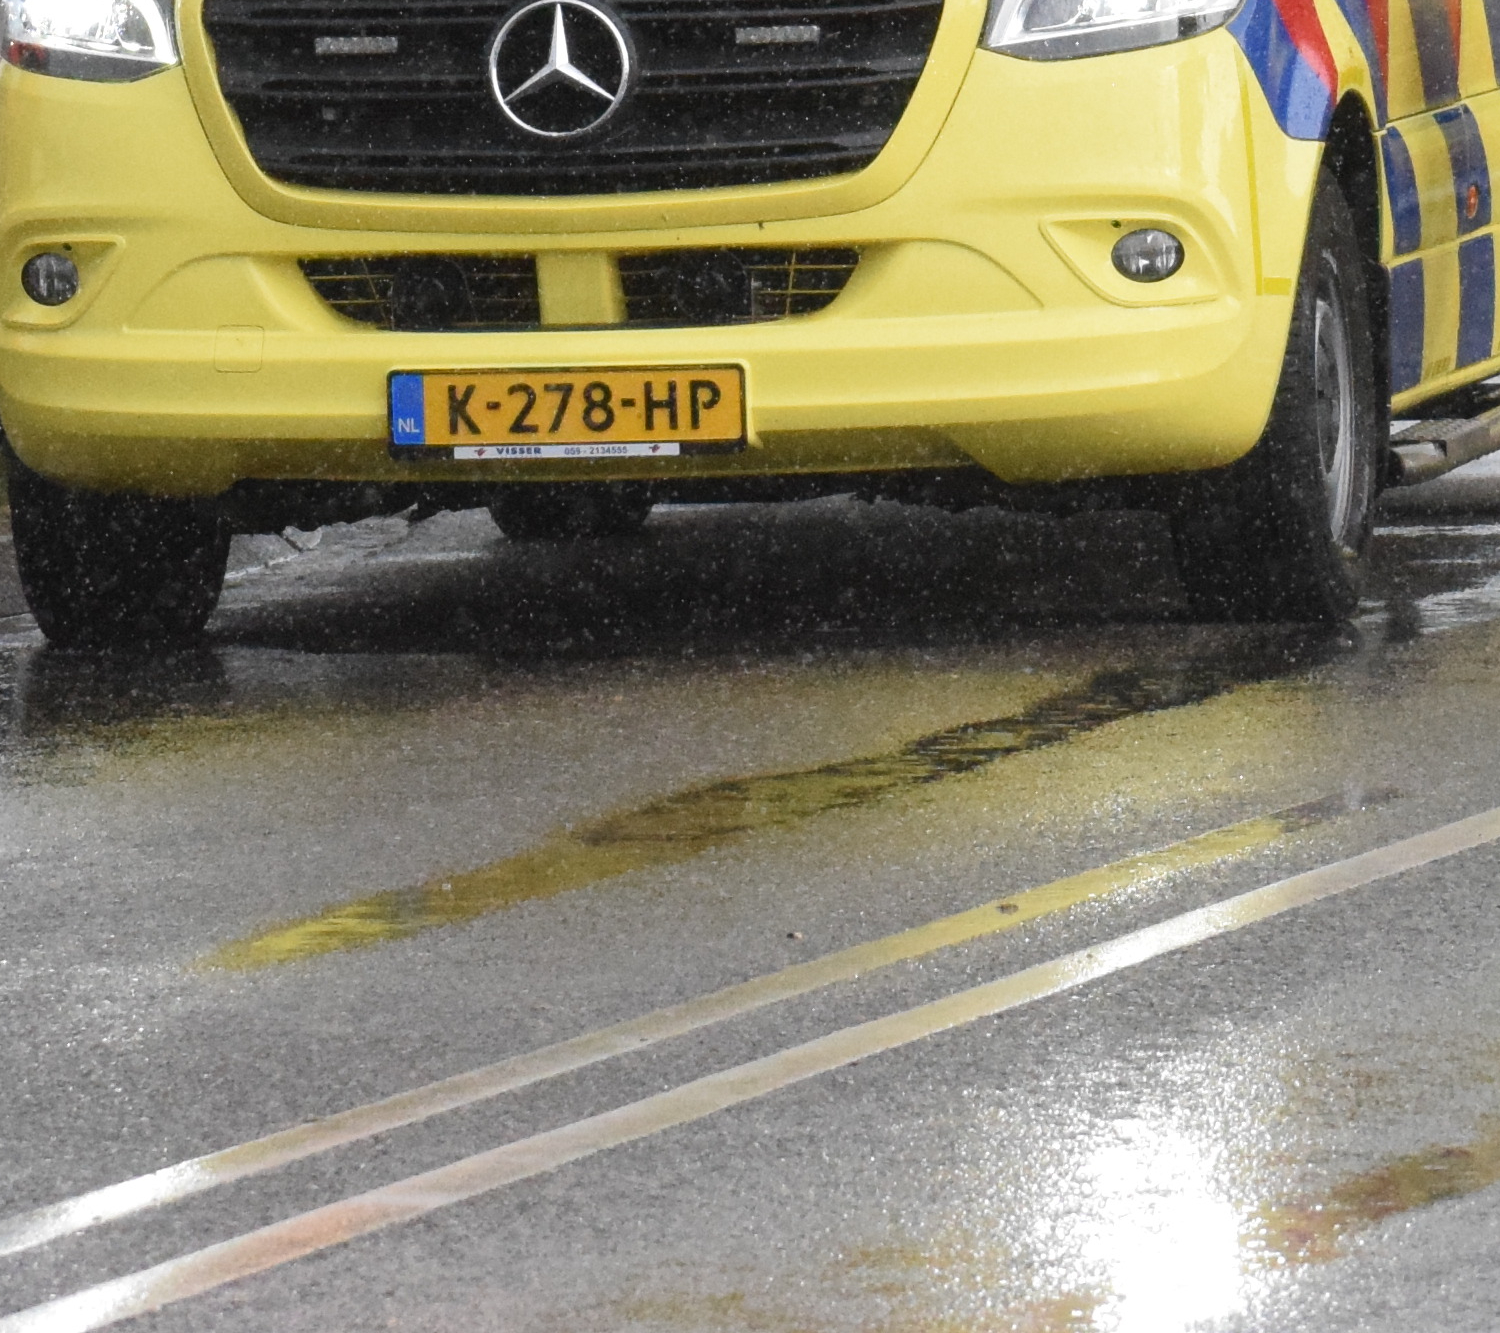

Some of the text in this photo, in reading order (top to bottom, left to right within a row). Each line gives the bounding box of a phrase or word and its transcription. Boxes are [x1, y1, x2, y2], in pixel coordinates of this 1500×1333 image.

[447, 379, 721, 435] K-278-HP
[398, 417, 421, 433] NL
[495, 446, 542, 455] VISSER
